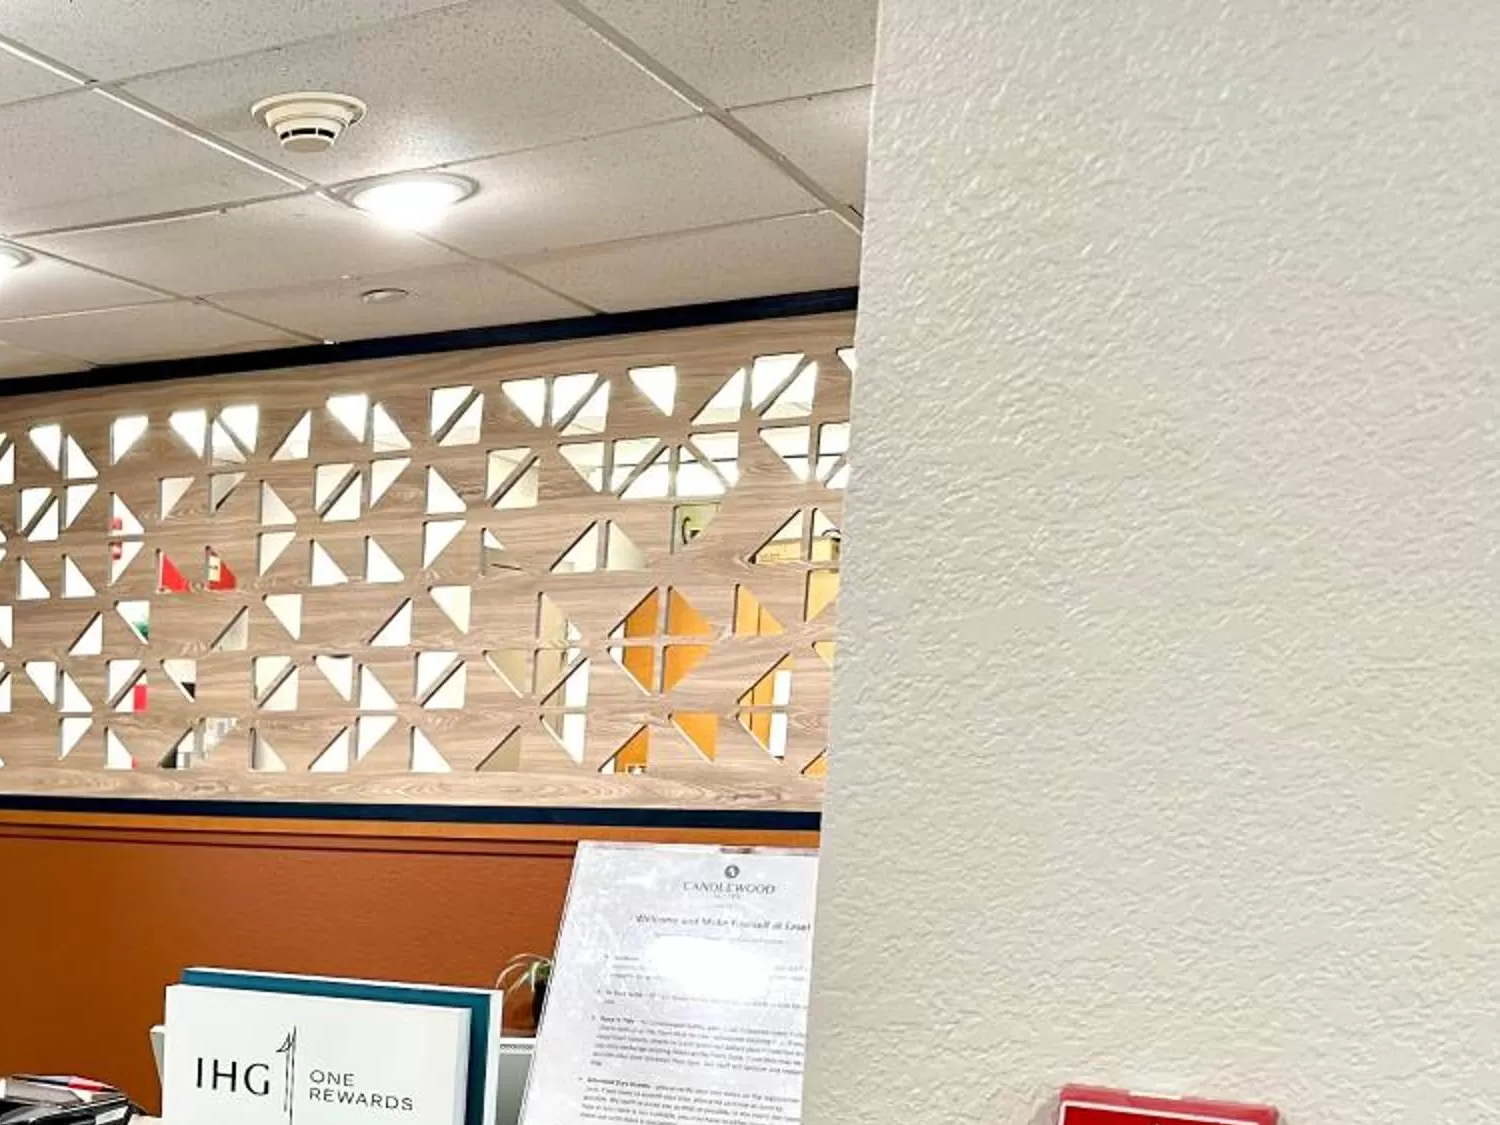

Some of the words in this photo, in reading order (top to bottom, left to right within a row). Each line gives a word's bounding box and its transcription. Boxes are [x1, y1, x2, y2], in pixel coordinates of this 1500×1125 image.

[683, 881, 776, 894] CANDLEWOOD
[196, 1057, 270, 1096] IHG
[309, 1069, 355, 1087] ONE
[309, 1088, 414, 1111] REWARDS
